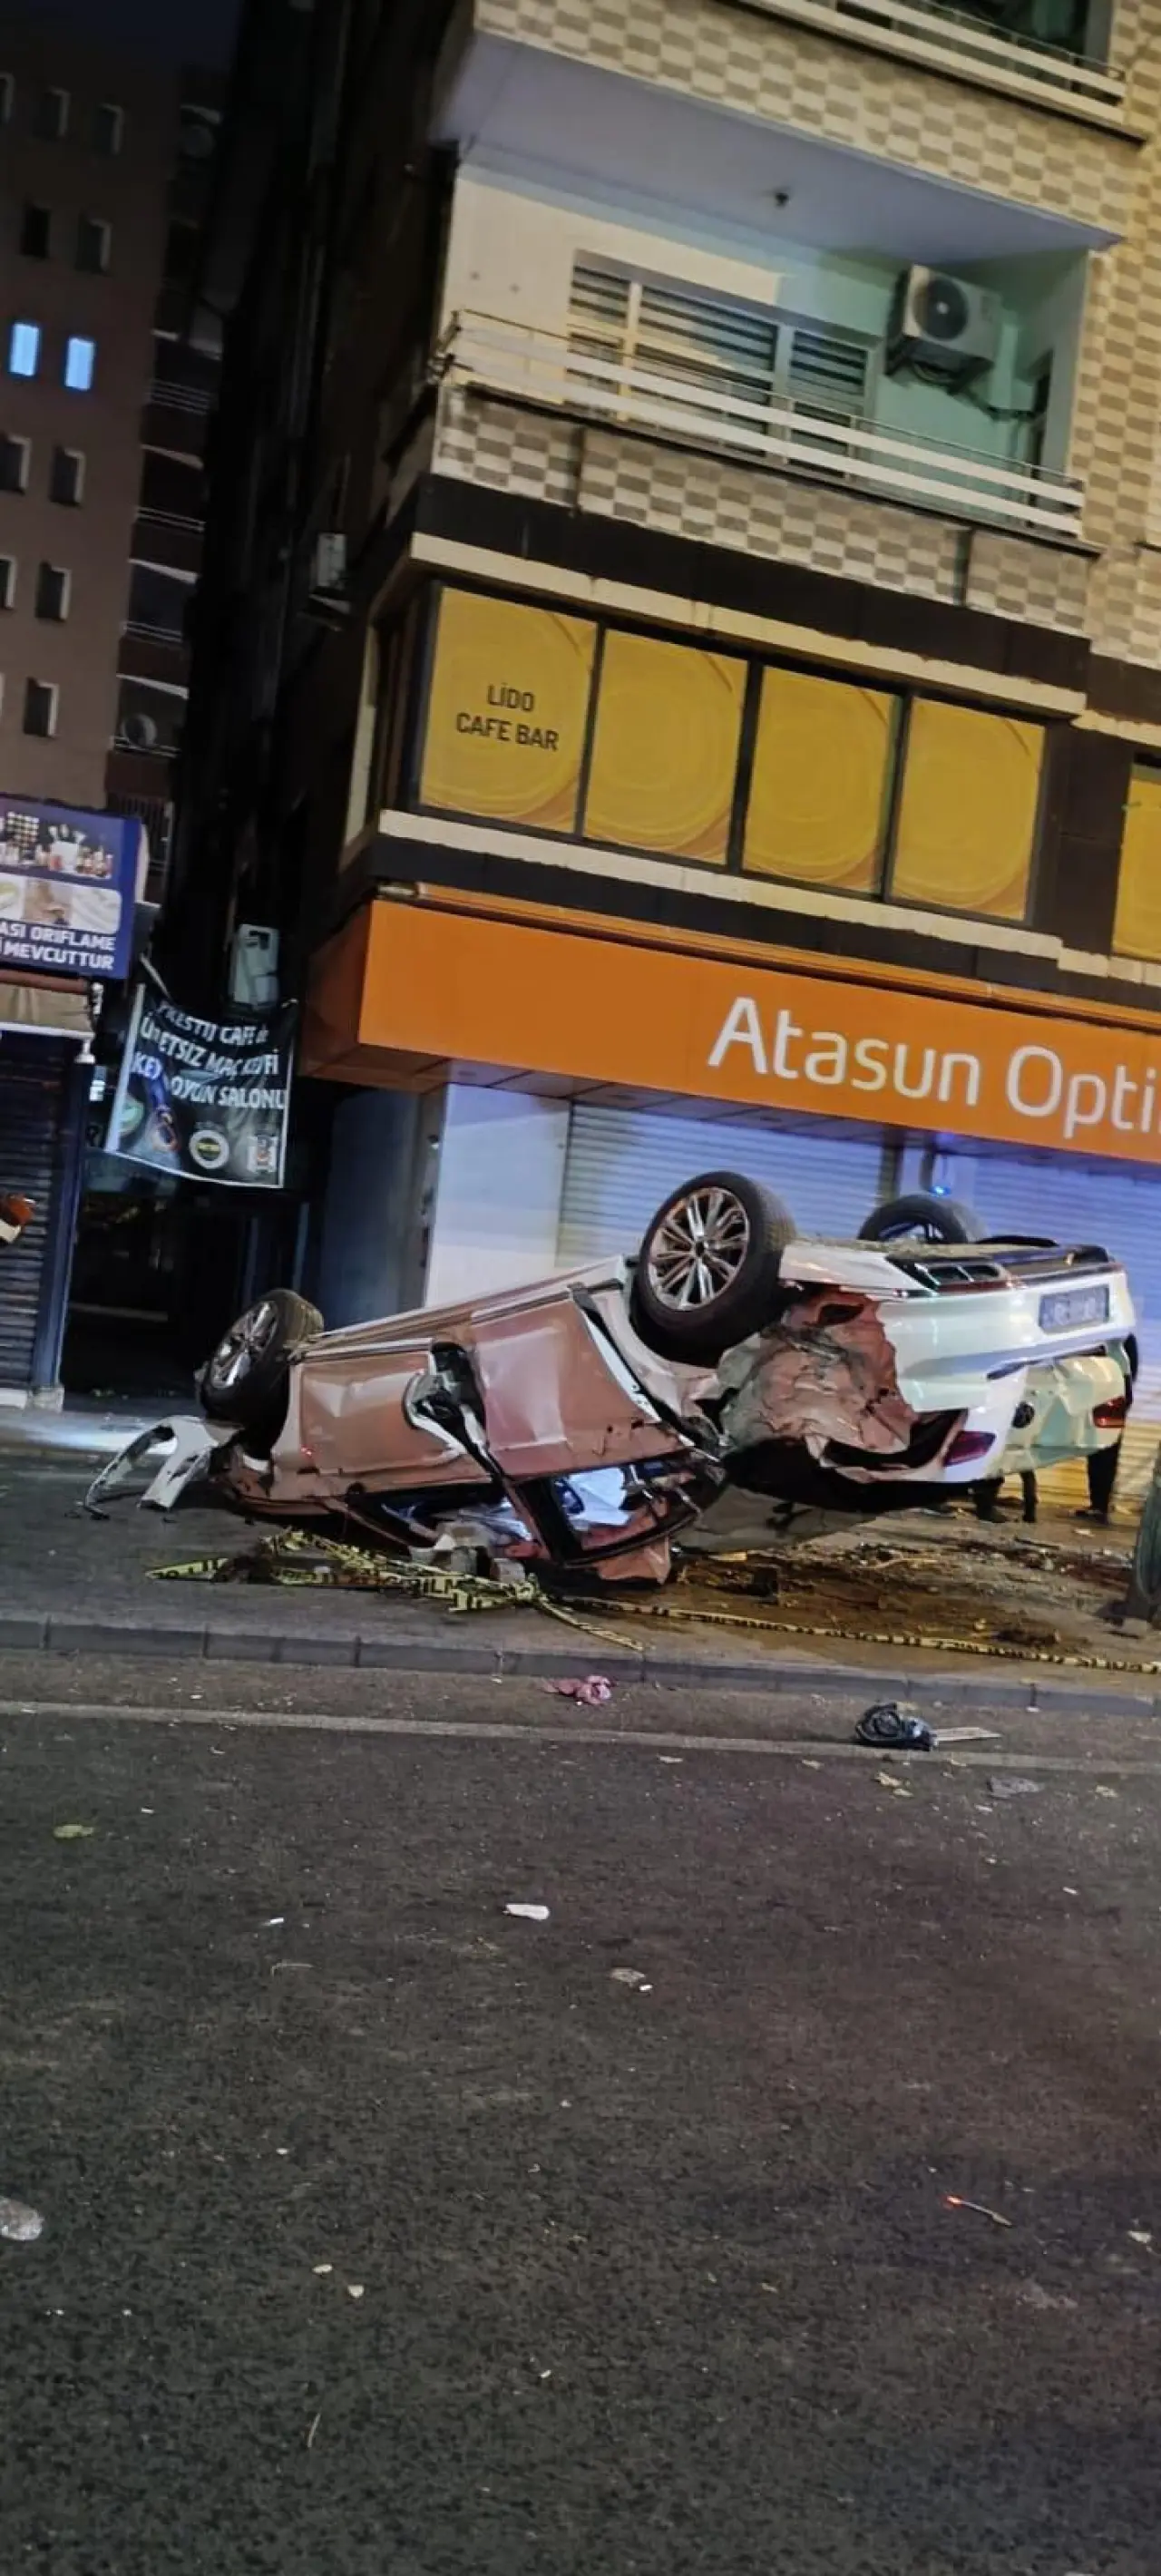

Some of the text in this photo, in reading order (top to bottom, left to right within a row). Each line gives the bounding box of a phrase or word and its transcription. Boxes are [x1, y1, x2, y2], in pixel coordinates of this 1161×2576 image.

[487, 682, 535, 712] LİDO
[455, 712, 560, 752] CAFE BAR
[30, 926, 116, 951] ORIFLAME
[4, 940, 114, 971] MEVCUTTUR
[707, 996, 1161, 1139] Atasun Opti
